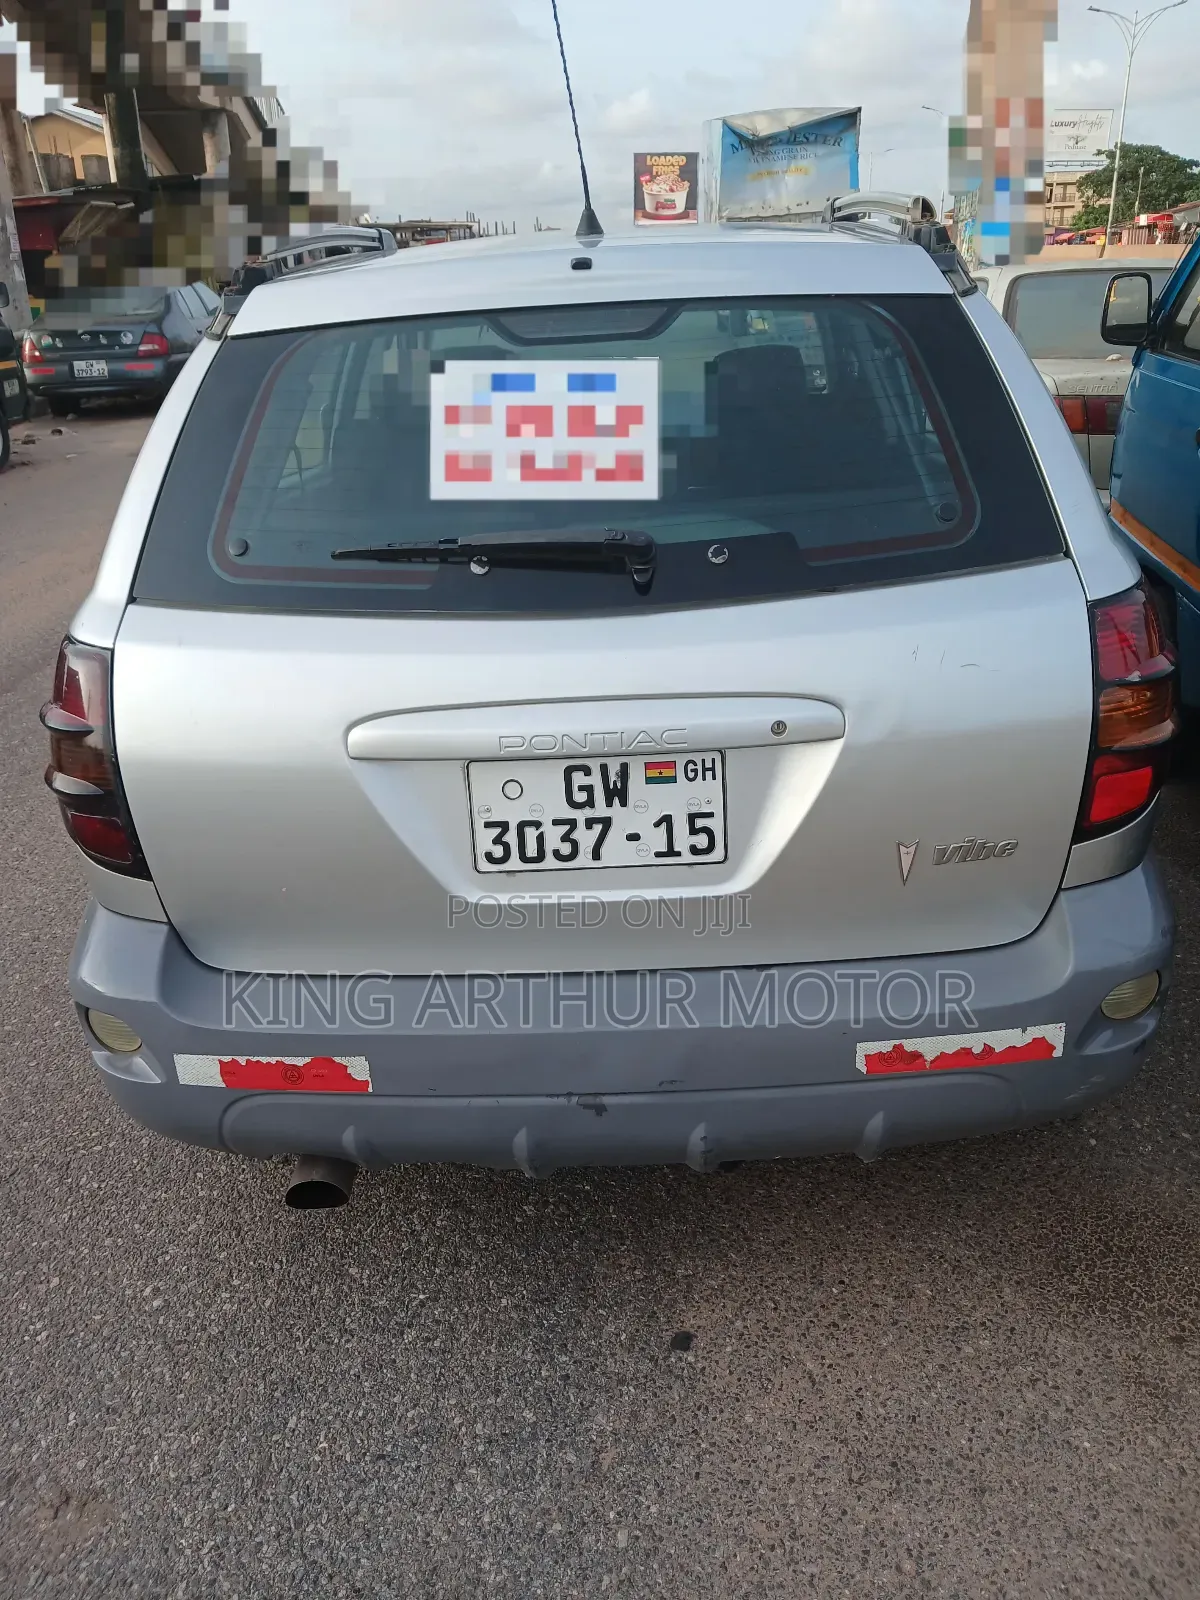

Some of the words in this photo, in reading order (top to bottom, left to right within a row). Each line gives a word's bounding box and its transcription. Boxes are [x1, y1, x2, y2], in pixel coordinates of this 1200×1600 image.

[1050, 120, 1077, 128] Luxury
[730, 132, 844, 154] MESTER
[782, 145, 808, 154] GRAIN
[499, 728, 687, 754] PONTIAC
[563, 762, 629, 810] GW
[683, 758, 717, 782] GH
[483, 811, 716, 865] 3037-15
[932, 836, 1018, 865] vibe
